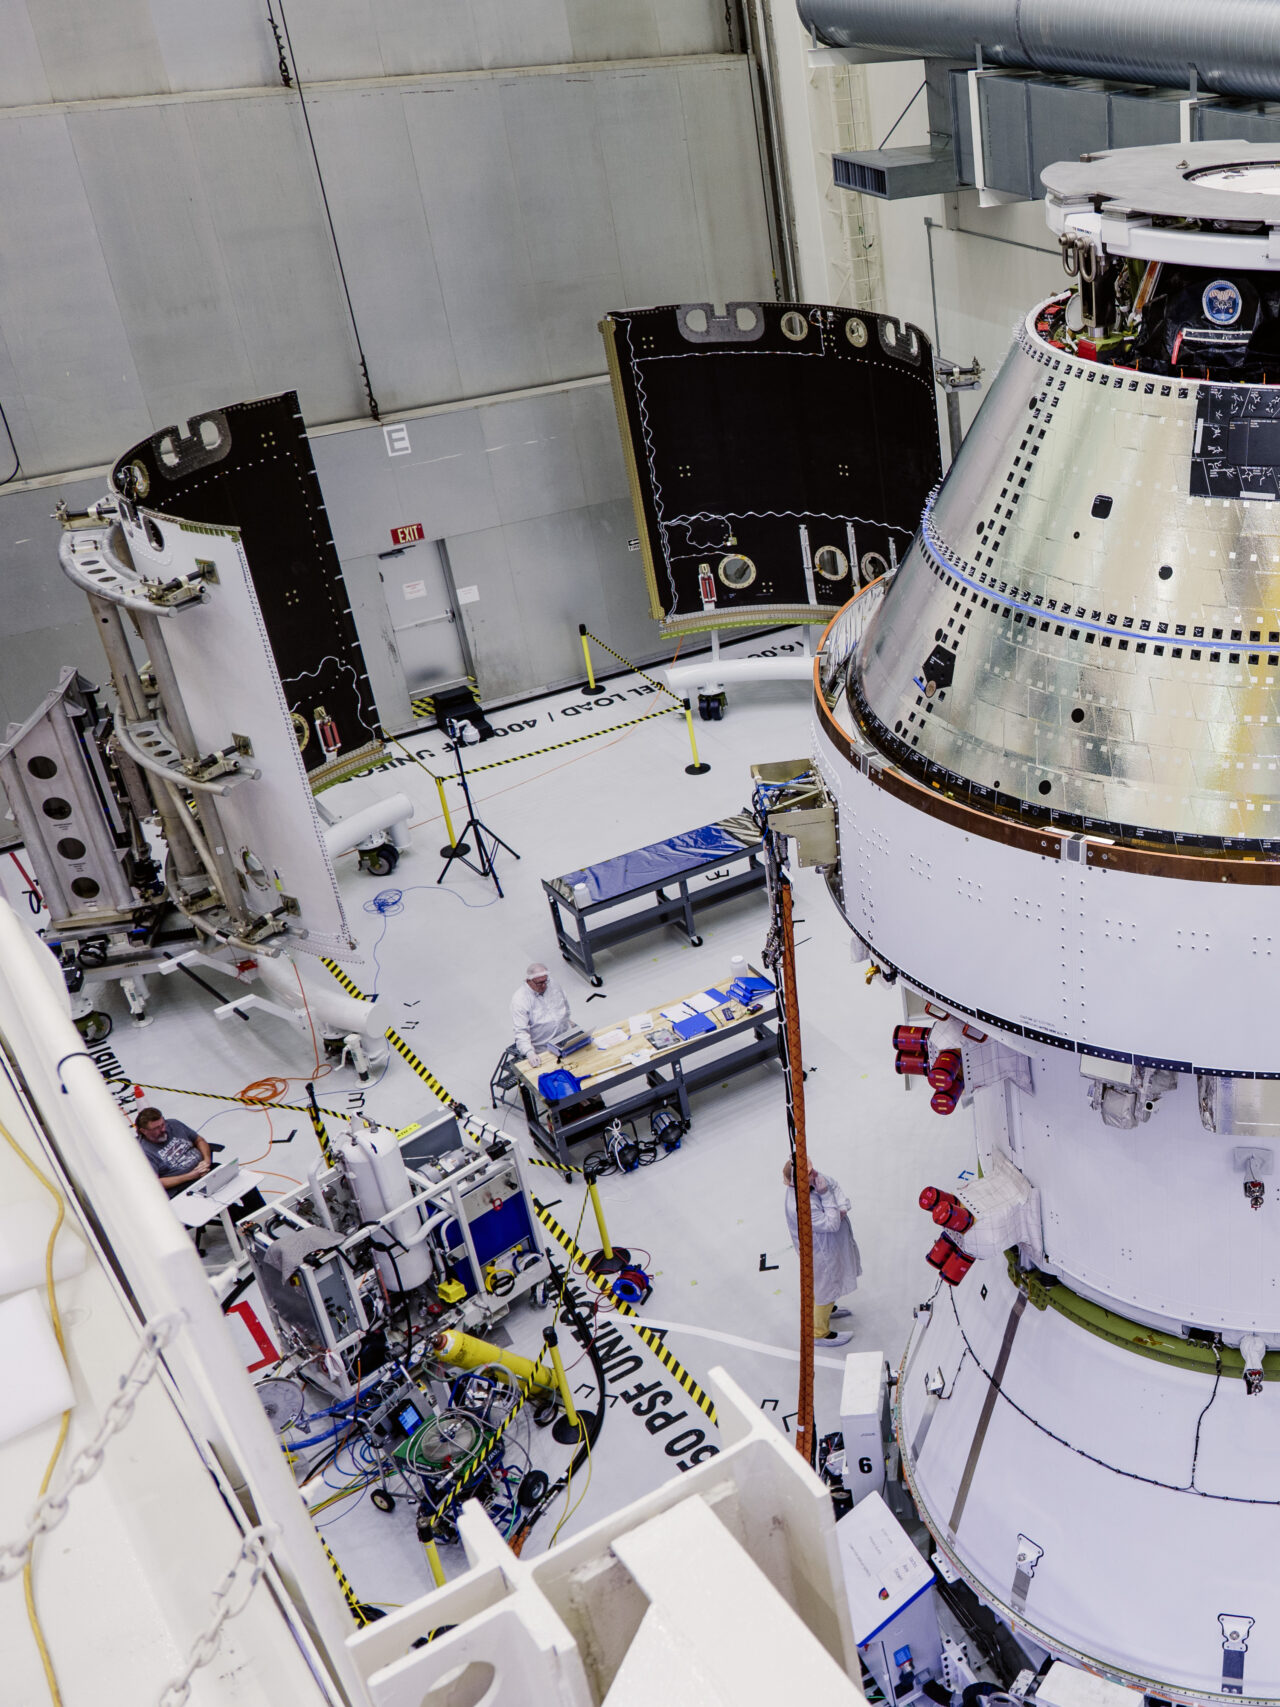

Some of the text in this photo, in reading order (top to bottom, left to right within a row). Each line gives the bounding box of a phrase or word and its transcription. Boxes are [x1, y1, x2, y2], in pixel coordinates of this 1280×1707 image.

[385, 427, 411, 457] E
[397, 525, 420, 543] EXIT
[561, 692, 627, 717] LOAD
[619, 1380, 689, 1436] PSF
[858, 1457, 873, 1474] 6
